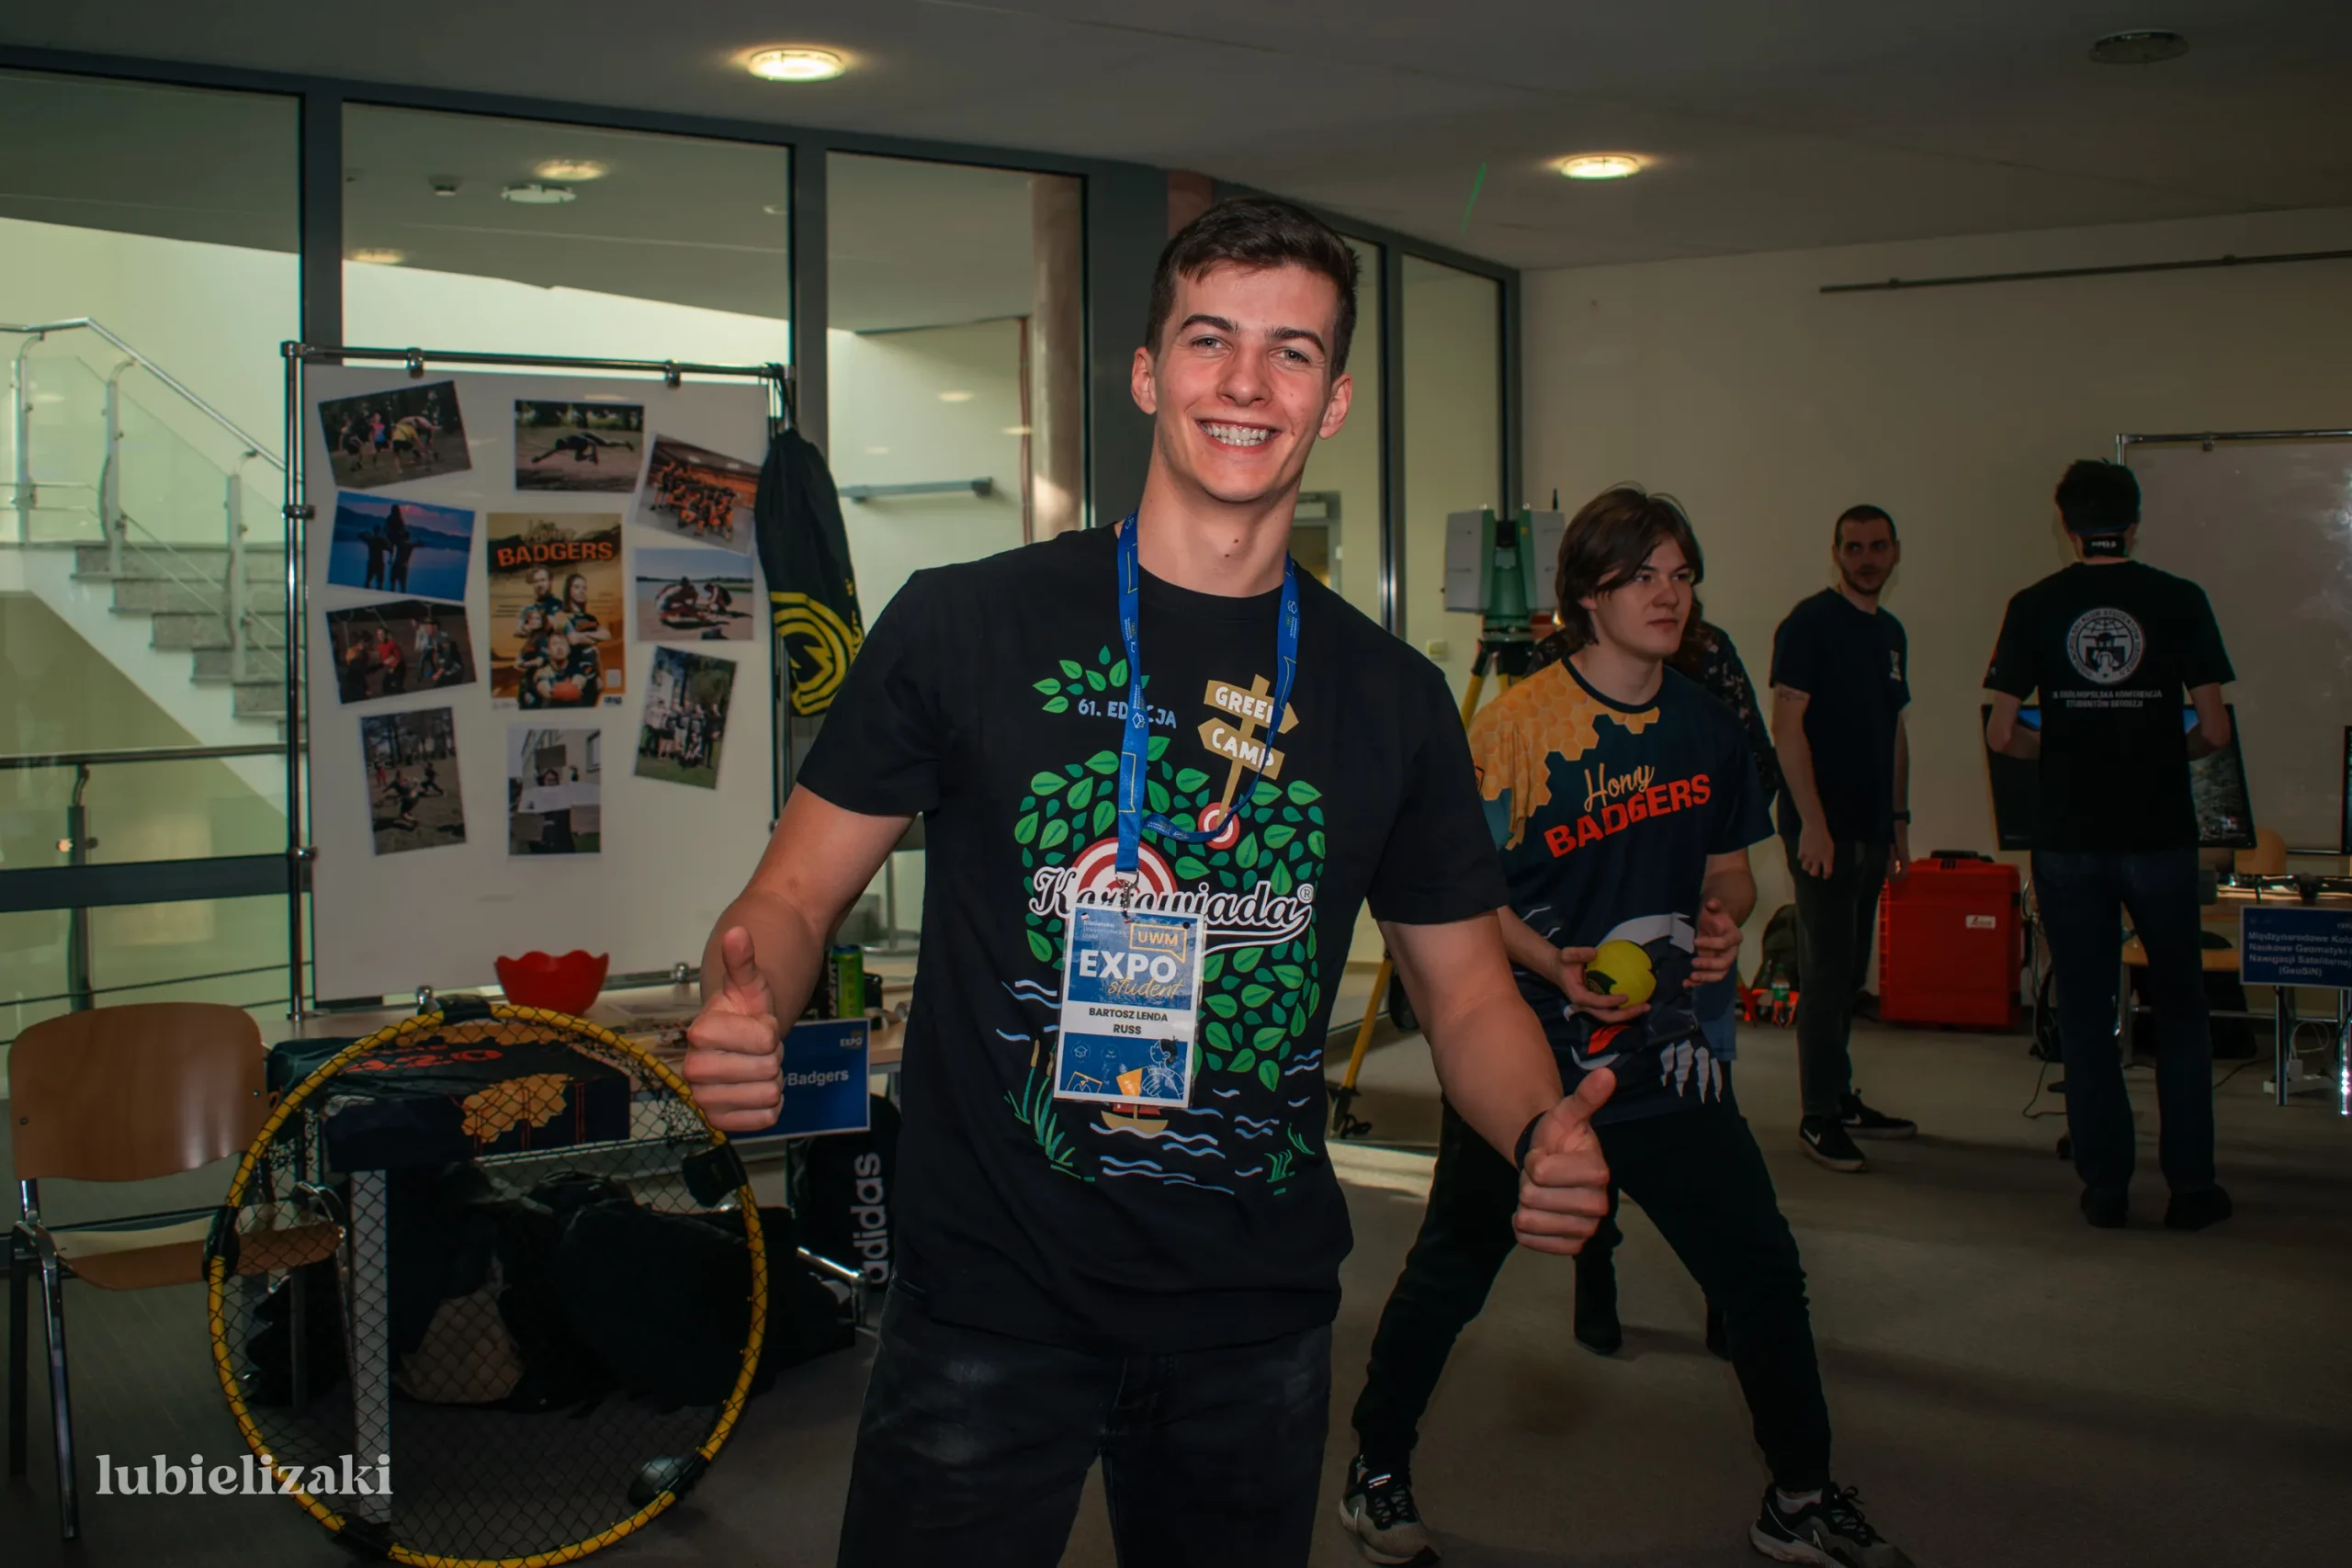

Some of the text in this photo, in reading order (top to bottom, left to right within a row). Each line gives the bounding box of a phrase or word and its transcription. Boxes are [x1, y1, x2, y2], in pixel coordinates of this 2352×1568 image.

[496, 541, 614, 568] BADGERS
[1078, 698, 1177, 729] 61. EDCJA
[1212, 728, 1274, 769] CAMP
[1544, 773, 1712, 859] BADGERS
[1137, 931, 1179, 946] UWM
[1079, 949, 1177, 984] EXPO
[1107, 975, 1183, 999] student
[1089, 1007, 1169, 1021] BARTOSZ LENDA
[1113, 1023, 1142, 1035] RUSS
[850, 1151, 889, 1285] adidas
